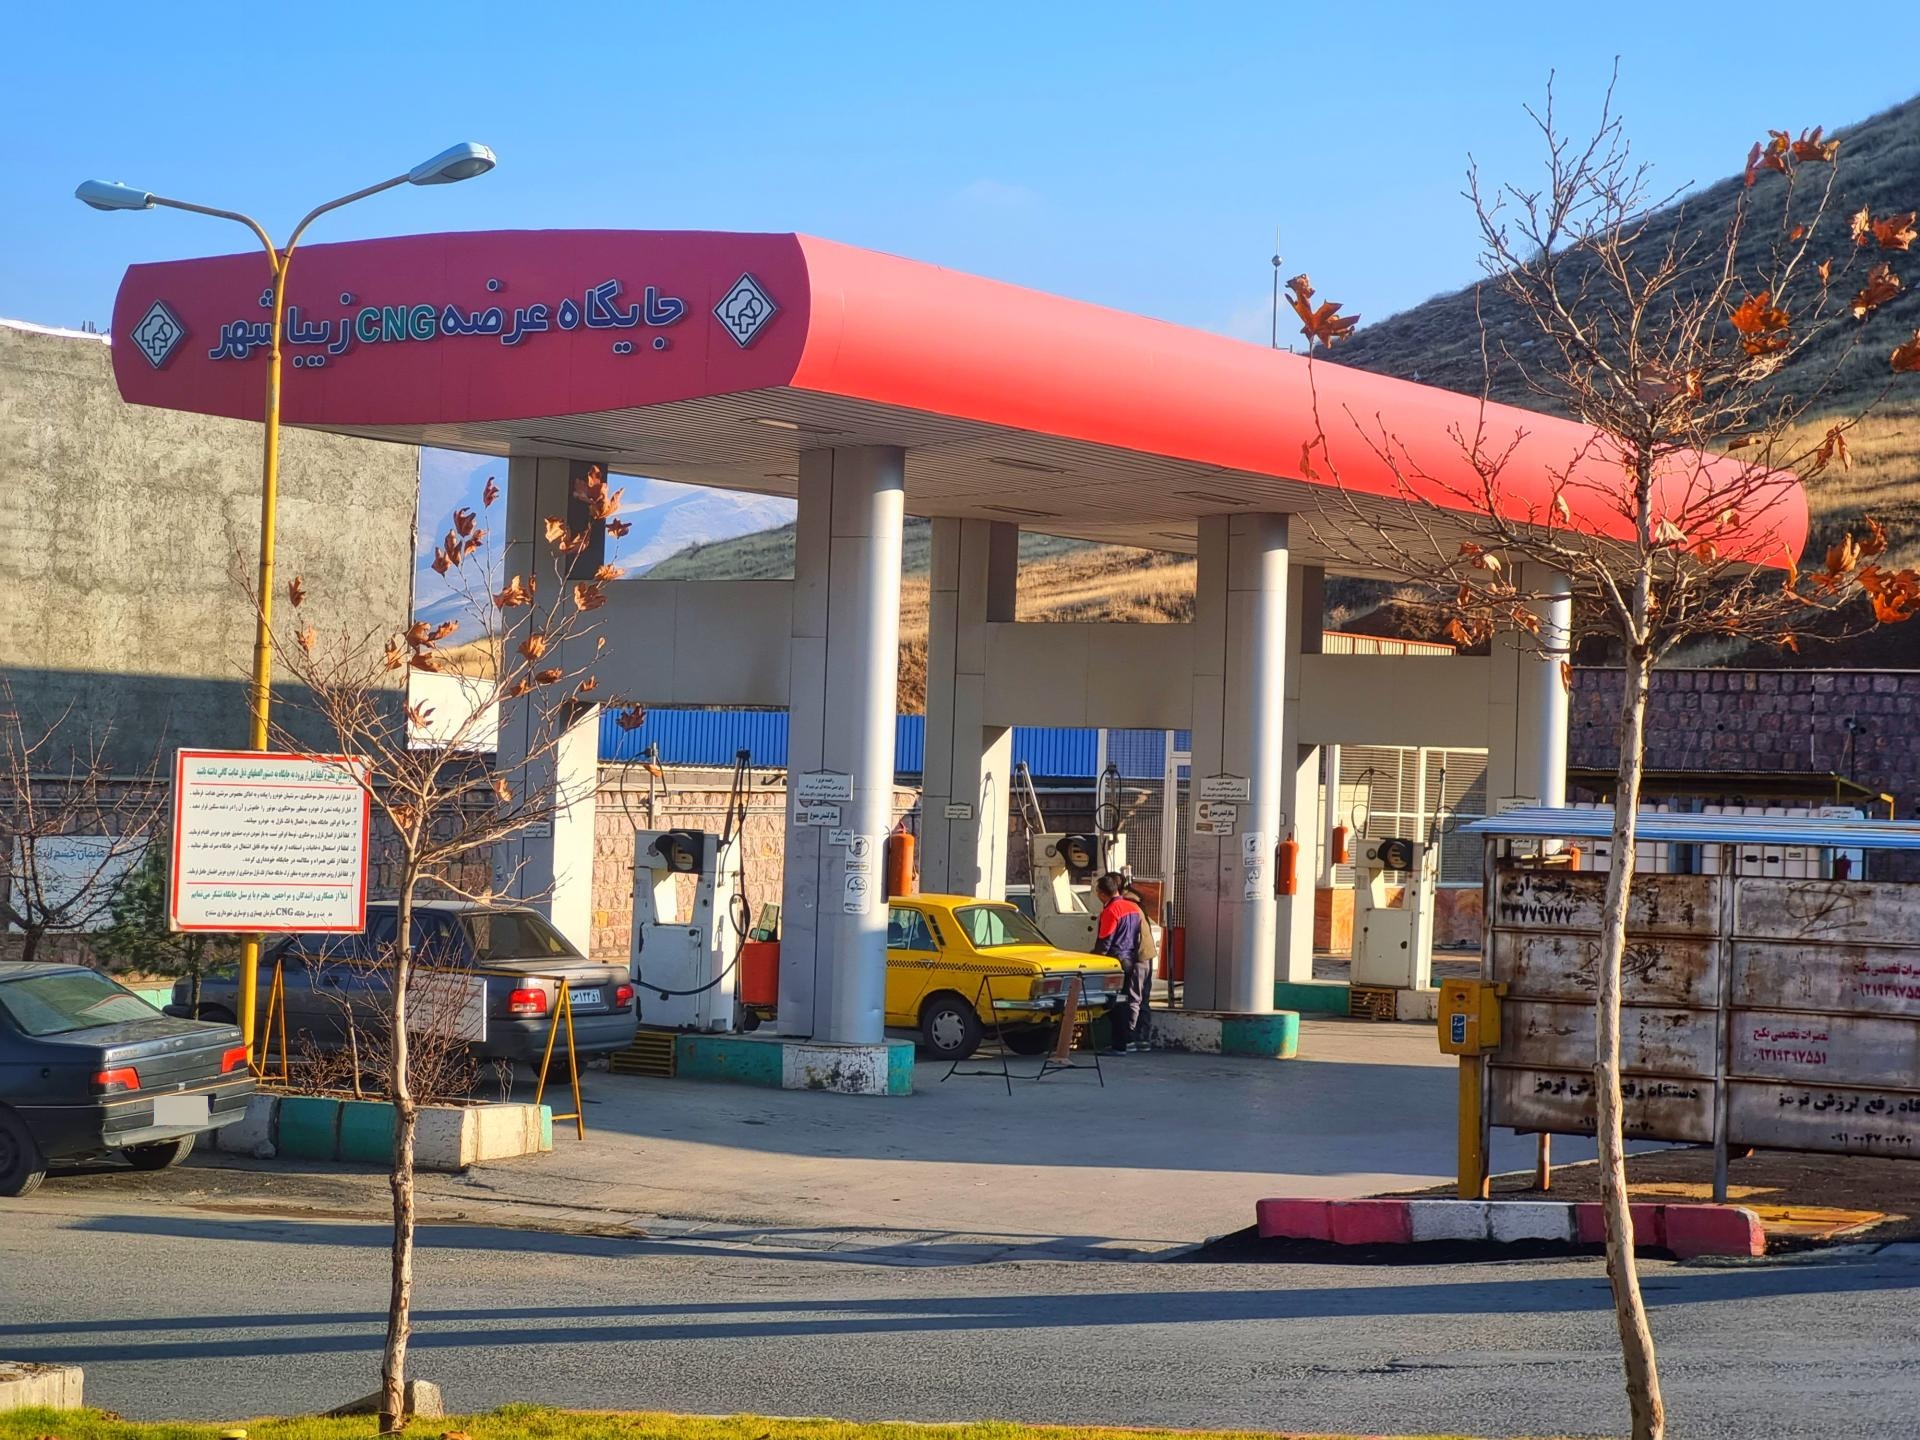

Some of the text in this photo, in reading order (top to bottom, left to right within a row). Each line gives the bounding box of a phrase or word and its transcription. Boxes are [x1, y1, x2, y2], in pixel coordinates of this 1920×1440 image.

[440, 278, 549, 345] عرضه
[557, 278, 684, 354] جایگاه
[355, 303, 437, 345] CNG
[1534, 1077, 1567, 1095] ترمز
[1648, 1082, 1699, 1099] دستگاه
[1814, 1092, 1860, 1112] لرزش
[1864, 1095, 1894, 1115] رفع
